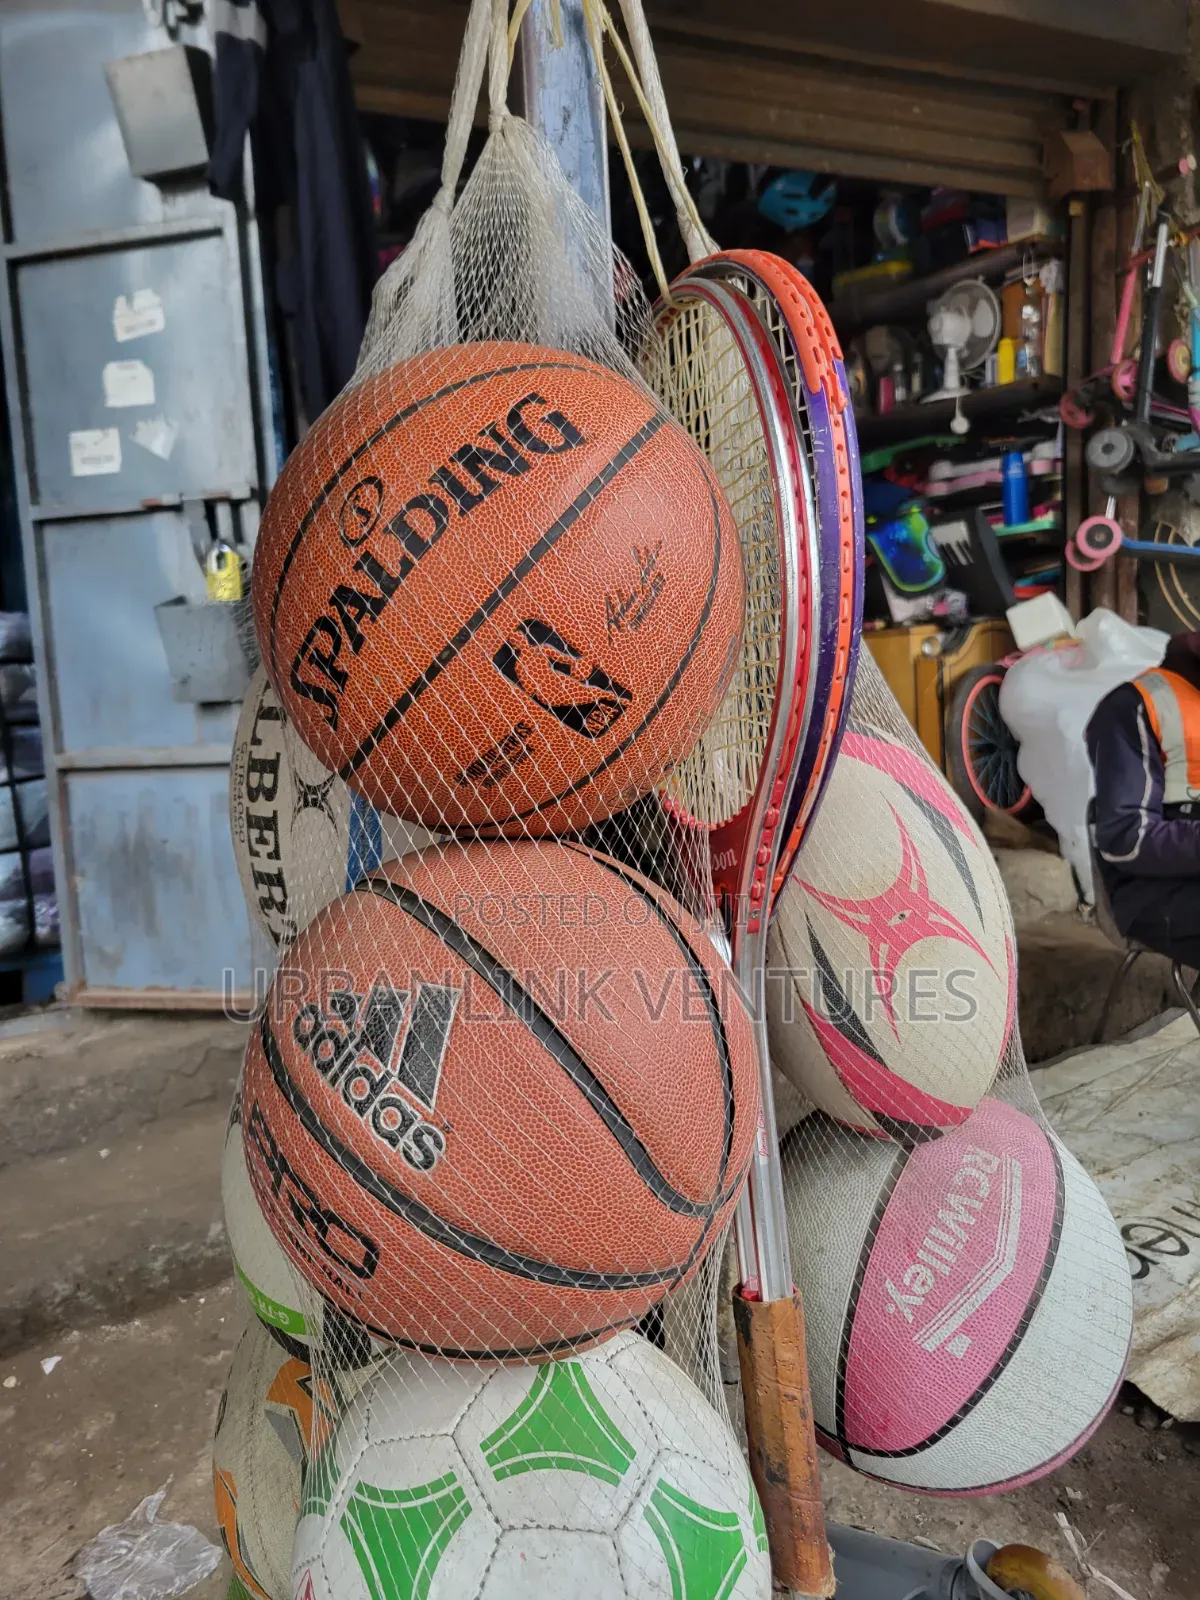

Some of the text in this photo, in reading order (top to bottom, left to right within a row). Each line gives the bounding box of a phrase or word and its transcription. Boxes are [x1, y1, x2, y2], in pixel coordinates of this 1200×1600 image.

[290, 391, 587, 731] SPALDING
[585, 704, 619, 733] NBA
[292, 1002, 447, 1174] adidas
